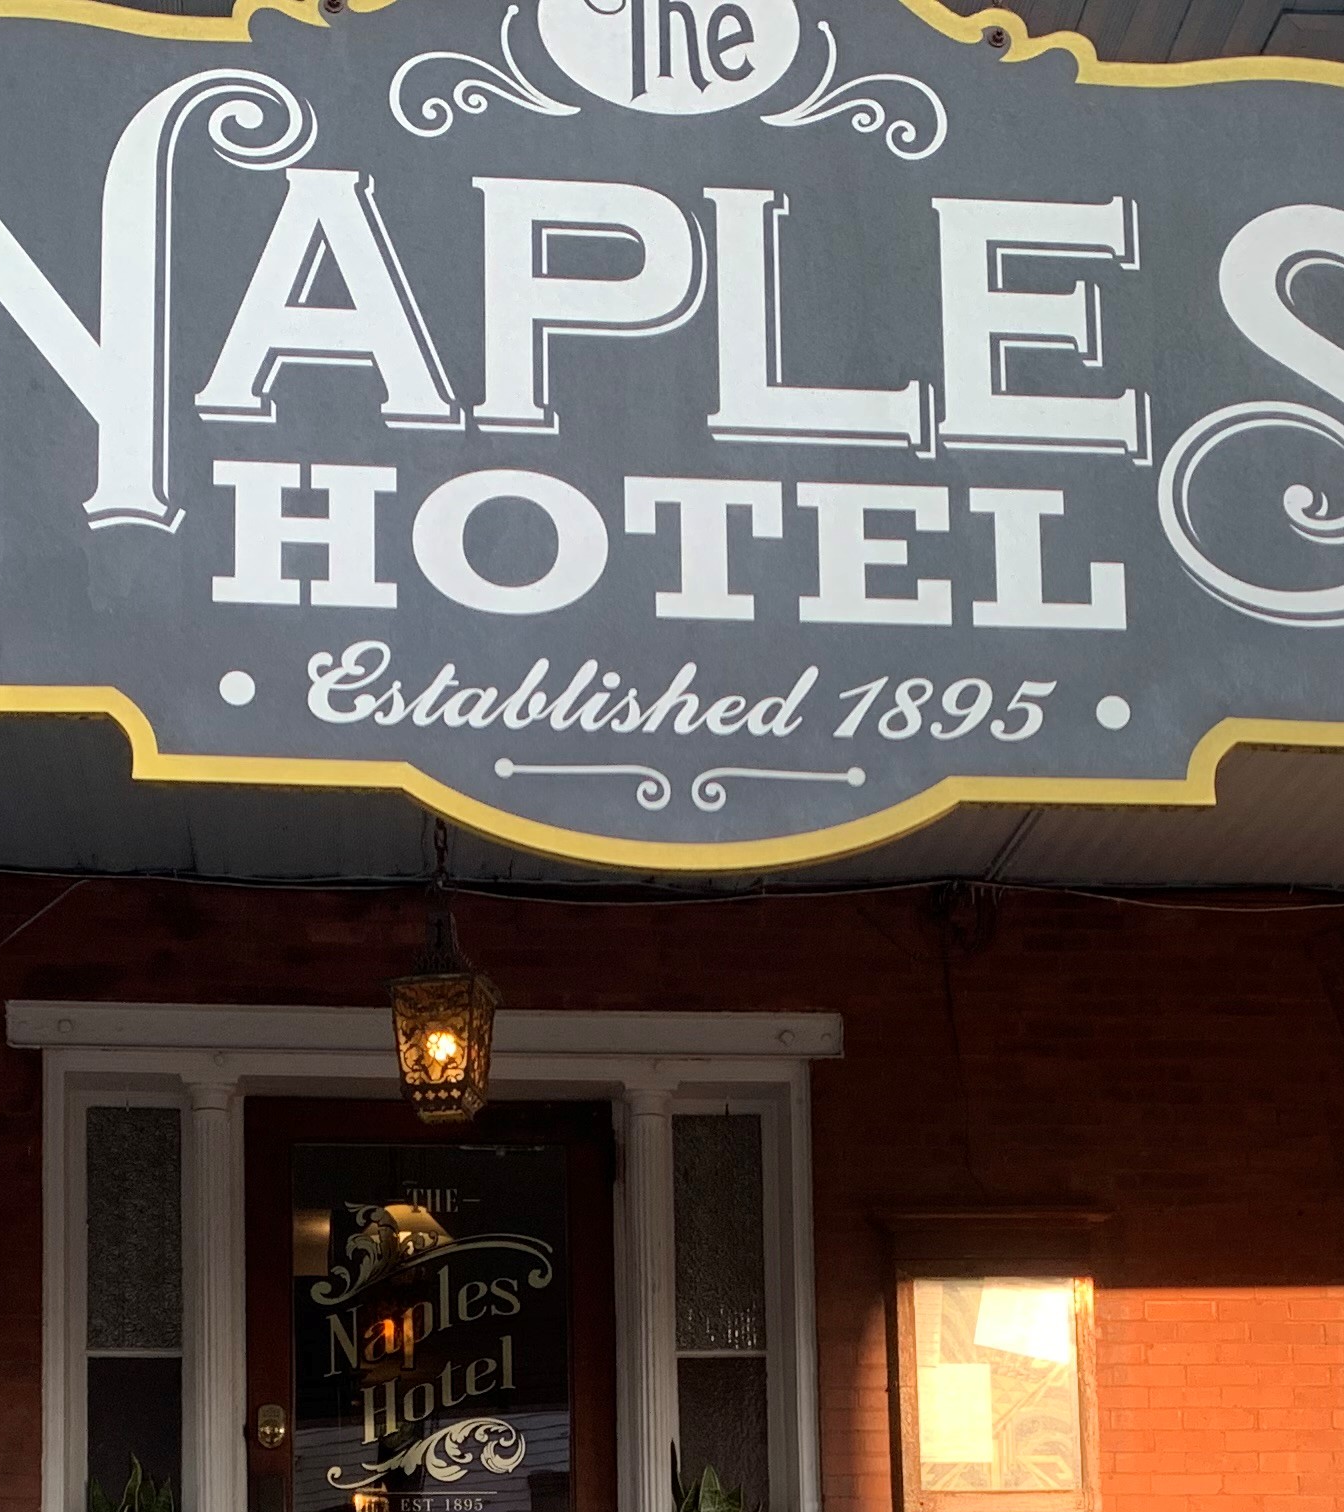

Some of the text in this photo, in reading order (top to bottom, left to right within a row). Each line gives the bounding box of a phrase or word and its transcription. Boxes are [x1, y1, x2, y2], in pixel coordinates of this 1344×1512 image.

[583, 0, 756, 102] The
[212, 459, 1128, 631] HOTEL
[307, 640, 1058, 743] Established 1895
[407, 1188, 459, 1214] THE
[324, 1265, 522, 1378] Naples
[360, 1335, 516, 1446] Hotel
[400, 1497, 484, 1512] EST 1895
